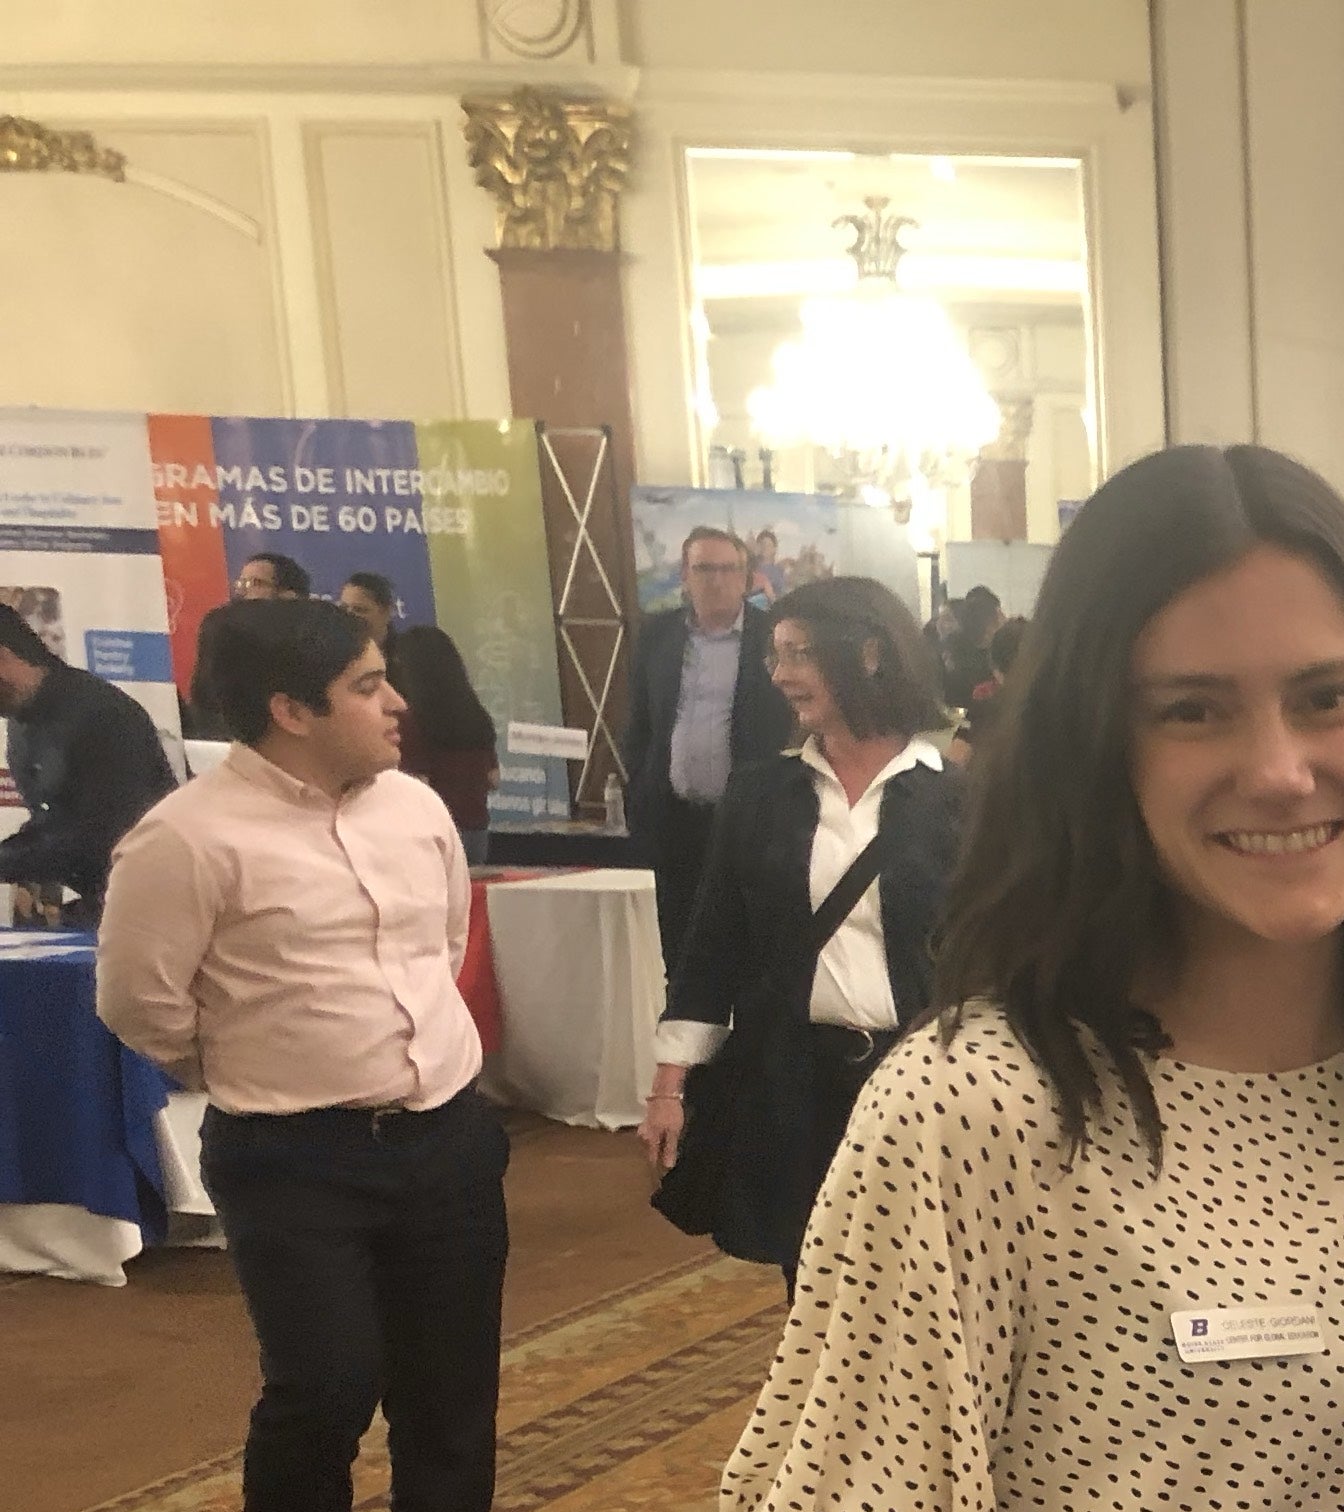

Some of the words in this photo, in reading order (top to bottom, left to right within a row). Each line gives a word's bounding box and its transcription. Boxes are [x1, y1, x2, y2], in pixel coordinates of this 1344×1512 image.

[295, 466, 336, 494] DE
[156, 501, 198, 528] EN
[208, 496, 283, 531] MÁS
[290, 503, 331, 532] DE
[338, 505, 377, 533] 60
